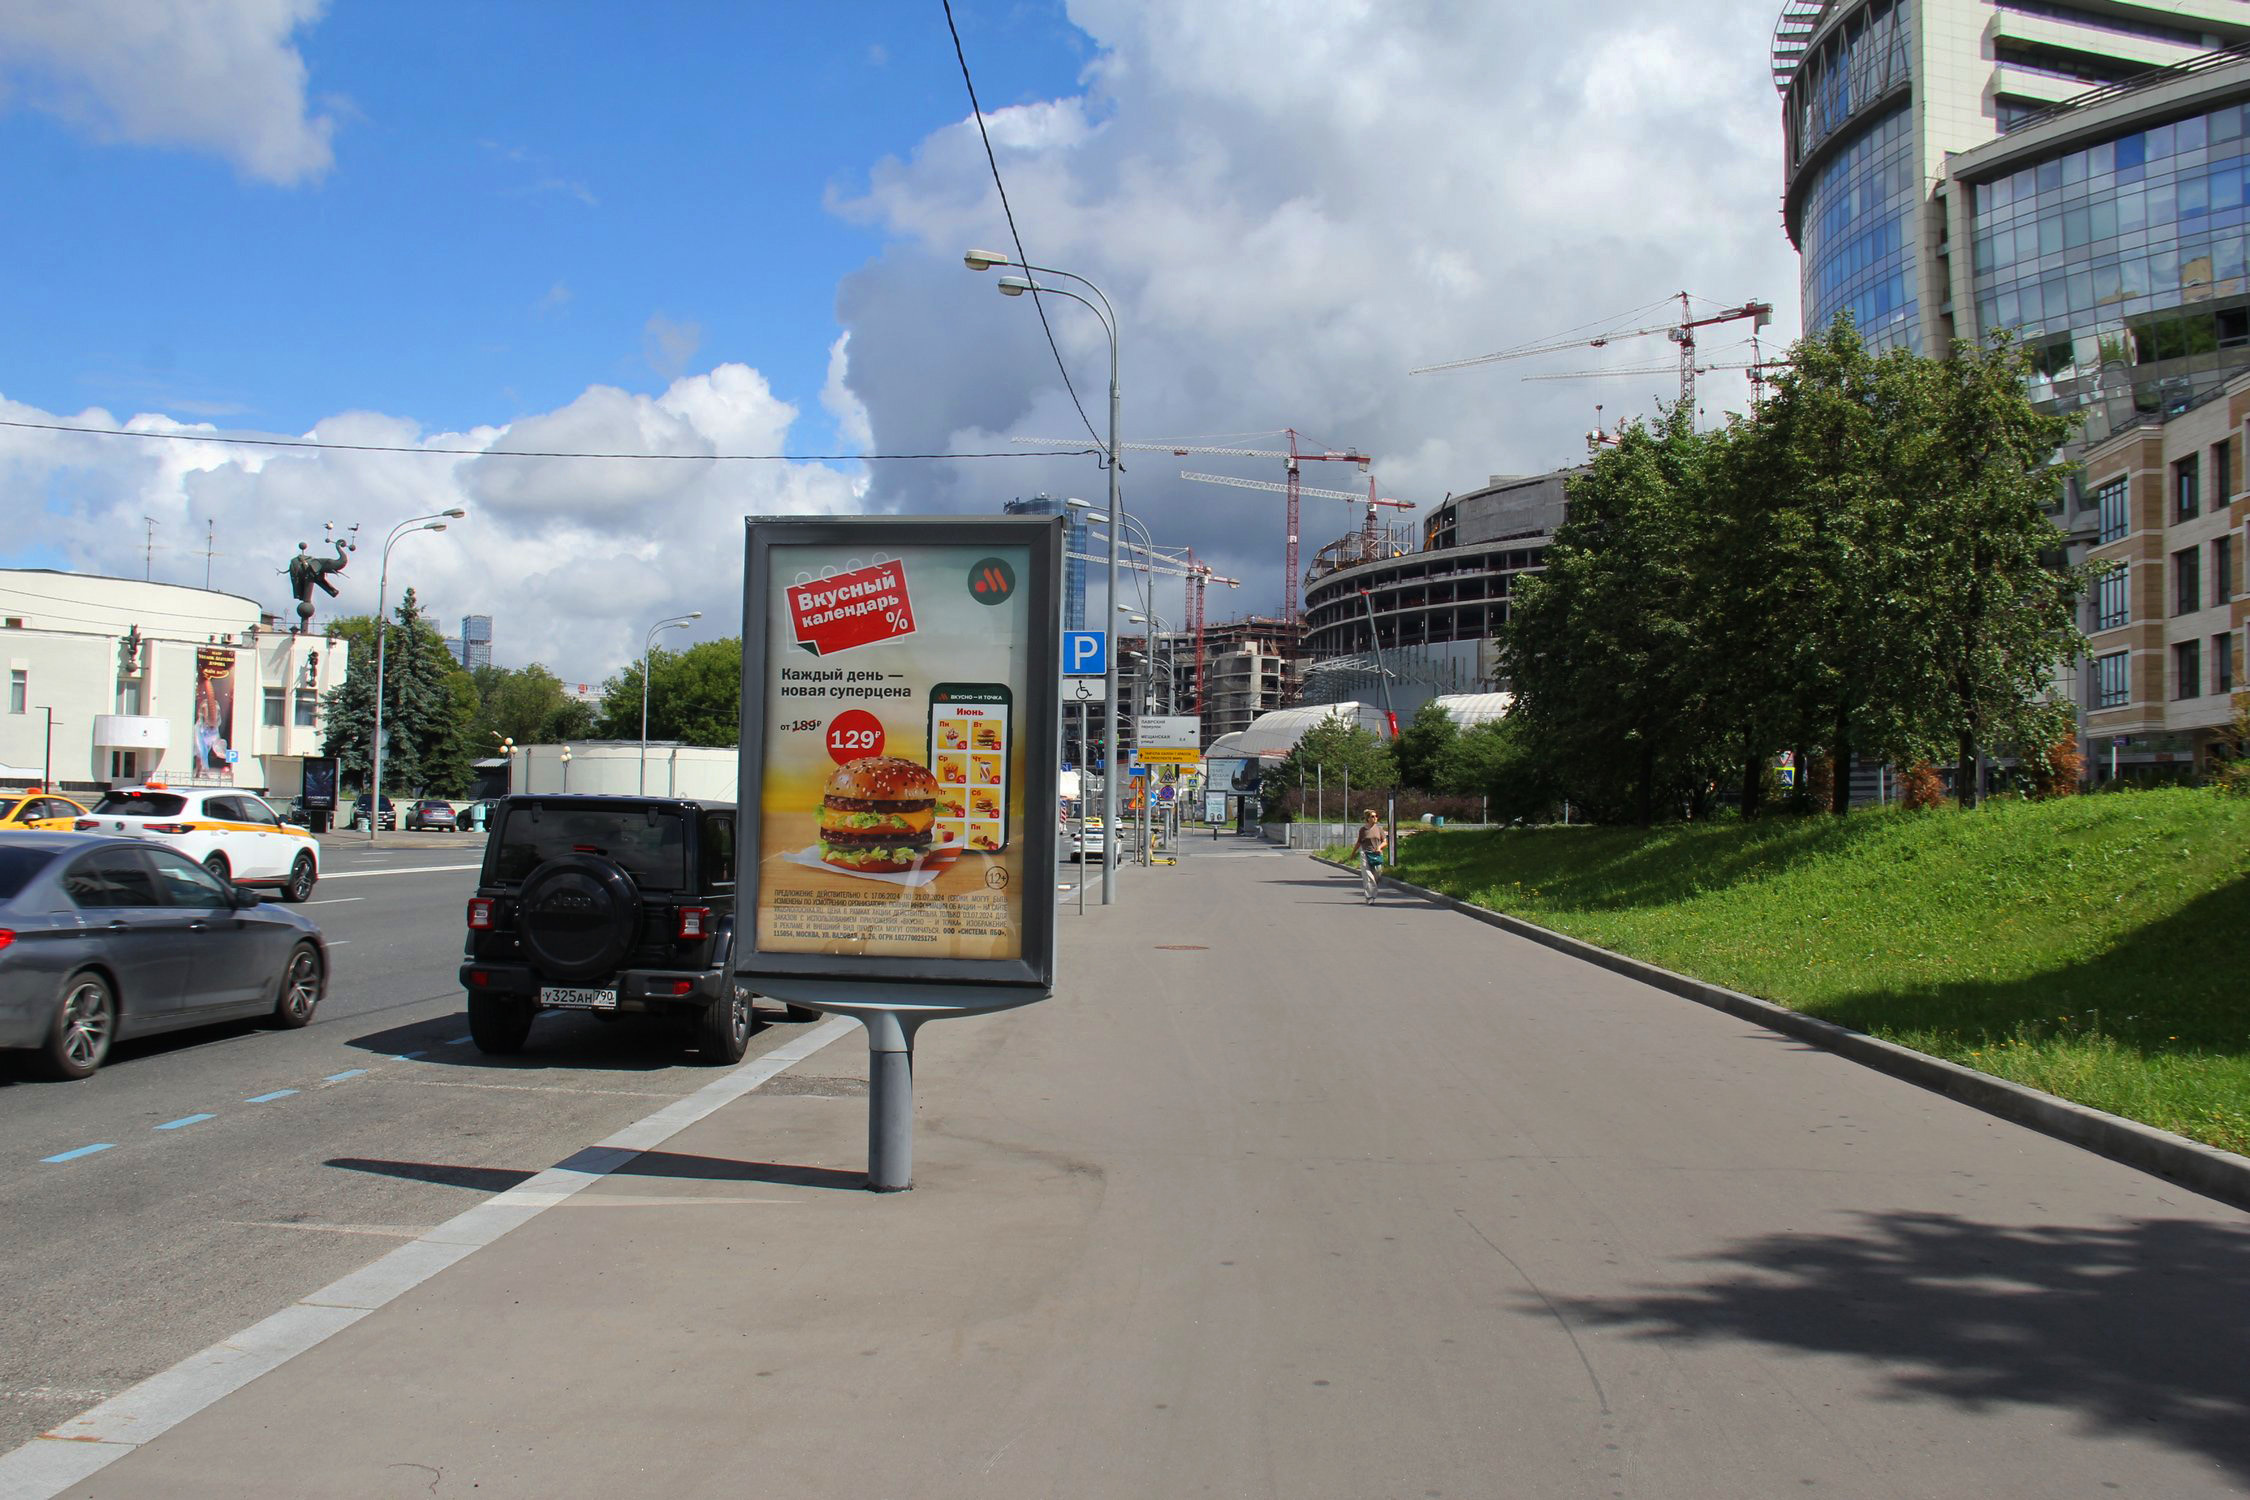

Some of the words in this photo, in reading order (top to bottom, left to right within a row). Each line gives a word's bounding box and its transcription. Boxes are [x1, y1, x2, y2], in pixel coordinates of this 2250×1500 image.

[797, 570, 896, 611] Вкусный
[801, 595, 899, 628] календарь
[885, 608, 909, 633] %
[781, 668, 843, 682] Каждый
[847, 670, 883, 682] день
[781, 686, 825, 696] новая
[829, 687, 911, 699] суперцена
[956, 708, 984, 716] Июнь
[989, 872, 1007, 884] 12+
[774, 889, 814, 897] ПРЕДЛОЖЕНИЕ
[816, 890, 861, 899] ДЕЙСТВИТЕЛЬНО
[812, 898, 847, 906] УСМОТРЕНИЮ
[966, 920, 1008, 928] ИЗОБРАЖЕНИЕ
[593, 991, 614, 1000] 790
